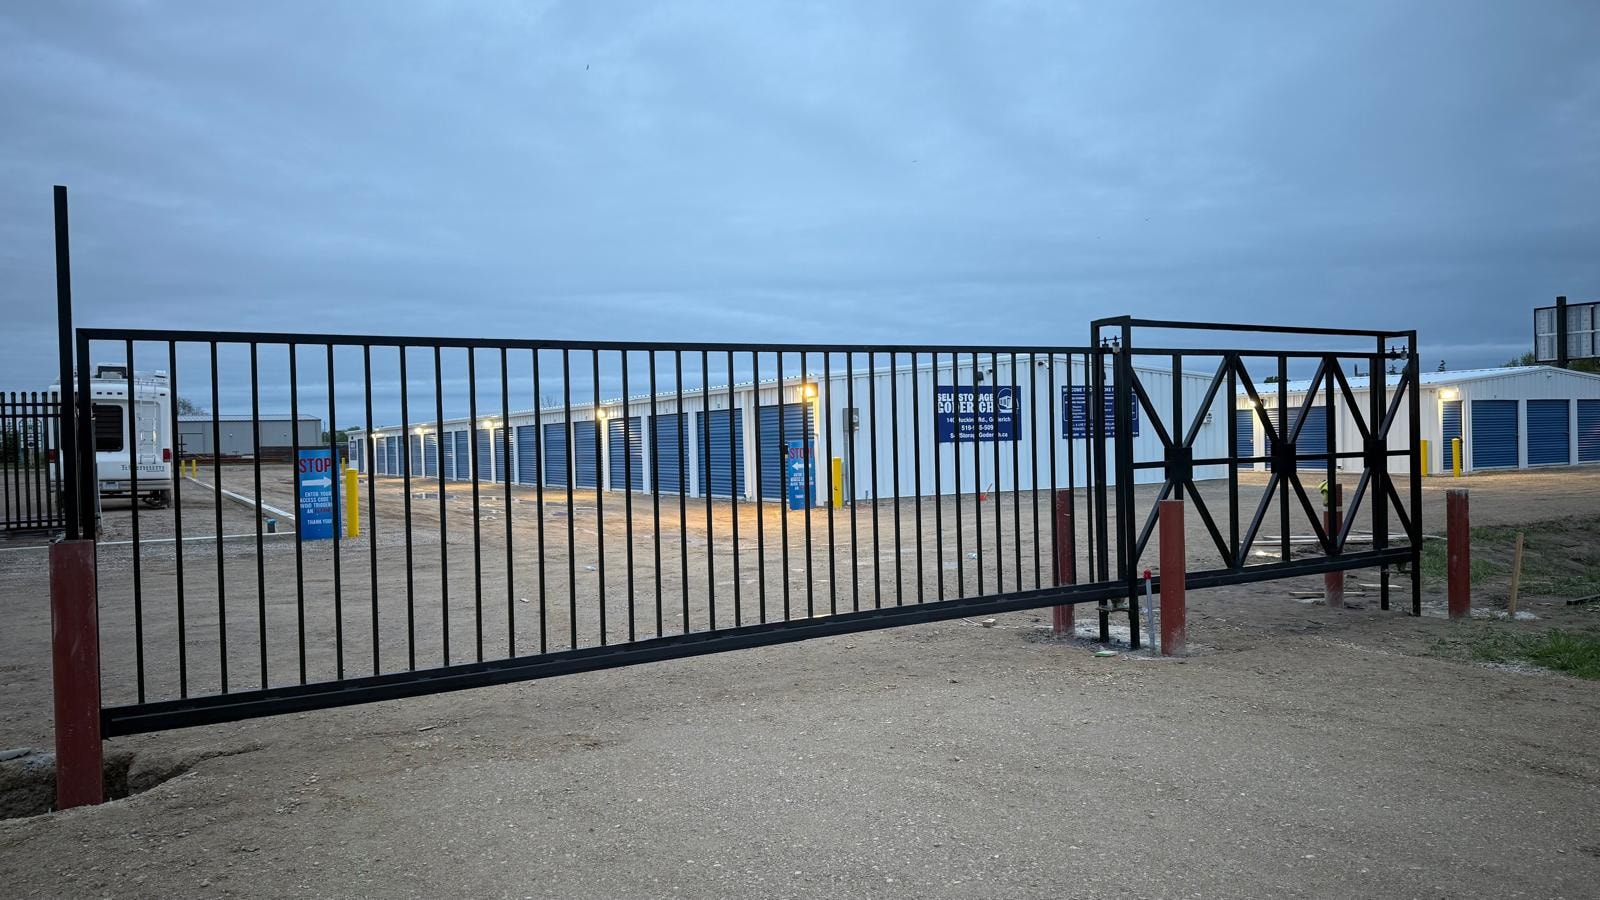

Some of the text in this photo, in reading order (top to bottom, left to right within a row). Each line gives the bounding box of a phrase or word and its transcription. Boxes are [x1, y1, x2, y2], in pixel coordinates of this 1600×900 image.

[958, 393, 994, 402] STOAGE
[937, 401, 994, 414] GOERCH
[299, 457, 332, 474] STOP
